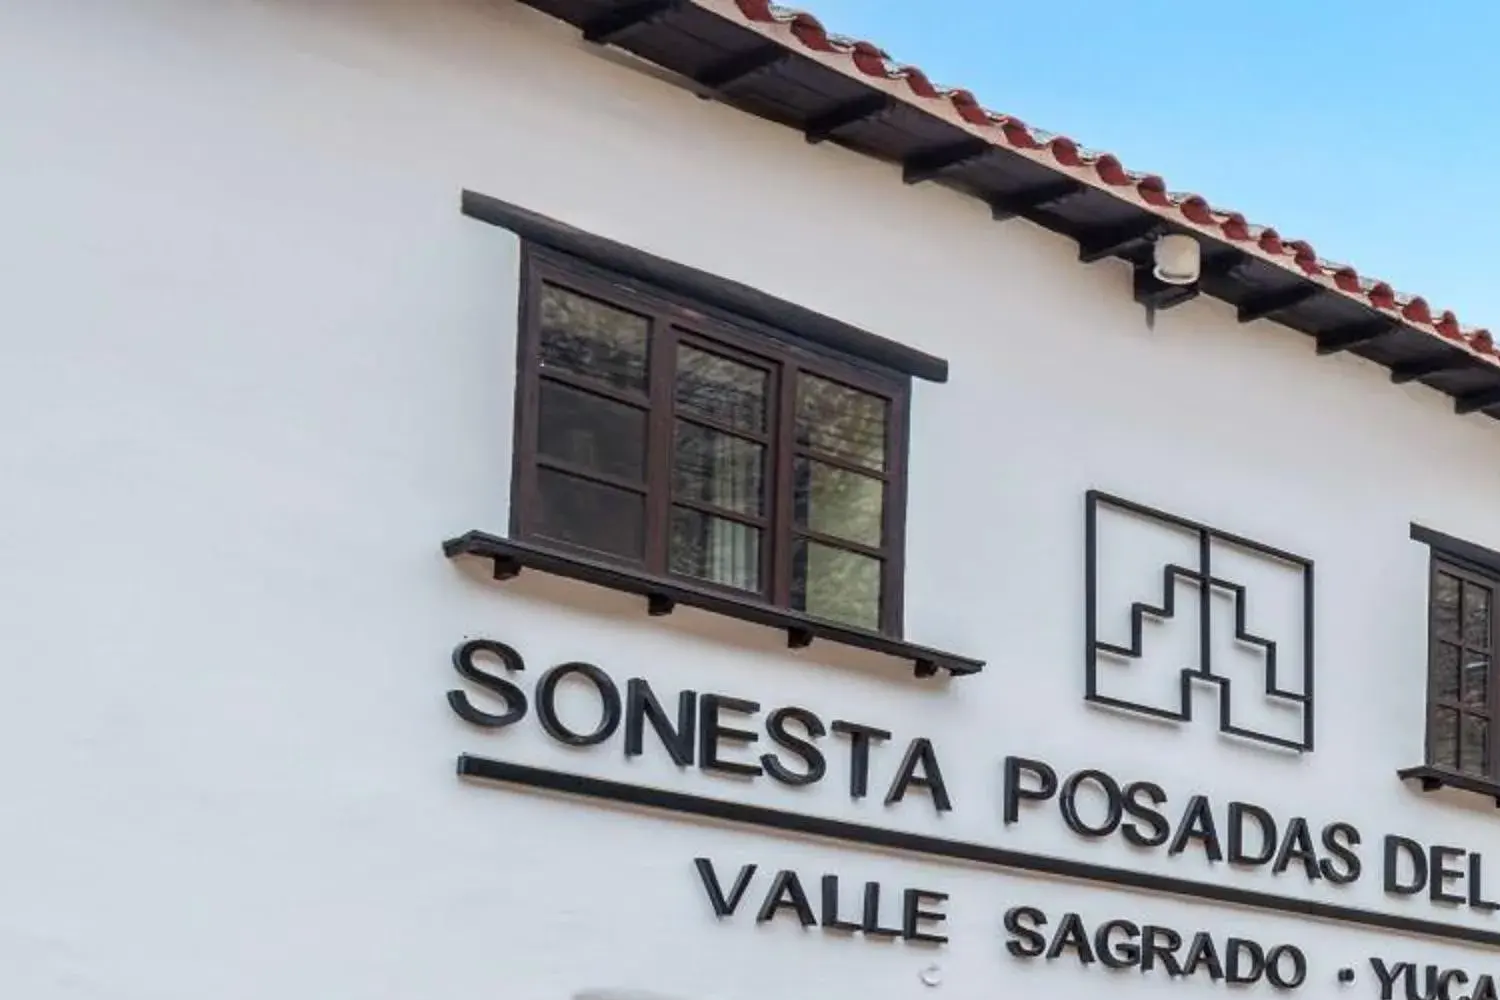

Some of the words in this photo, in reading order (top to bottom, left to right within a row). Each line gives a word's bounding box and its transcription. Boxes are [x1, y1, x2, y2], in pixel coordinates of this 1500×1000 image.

[446, 638, 953, 813] SONESTA
[1003, 755, 1362, 886] POSADAS
[694, 857, 949, 948] VALLE
[1003, 906, 1307, 992] SAGRADO
